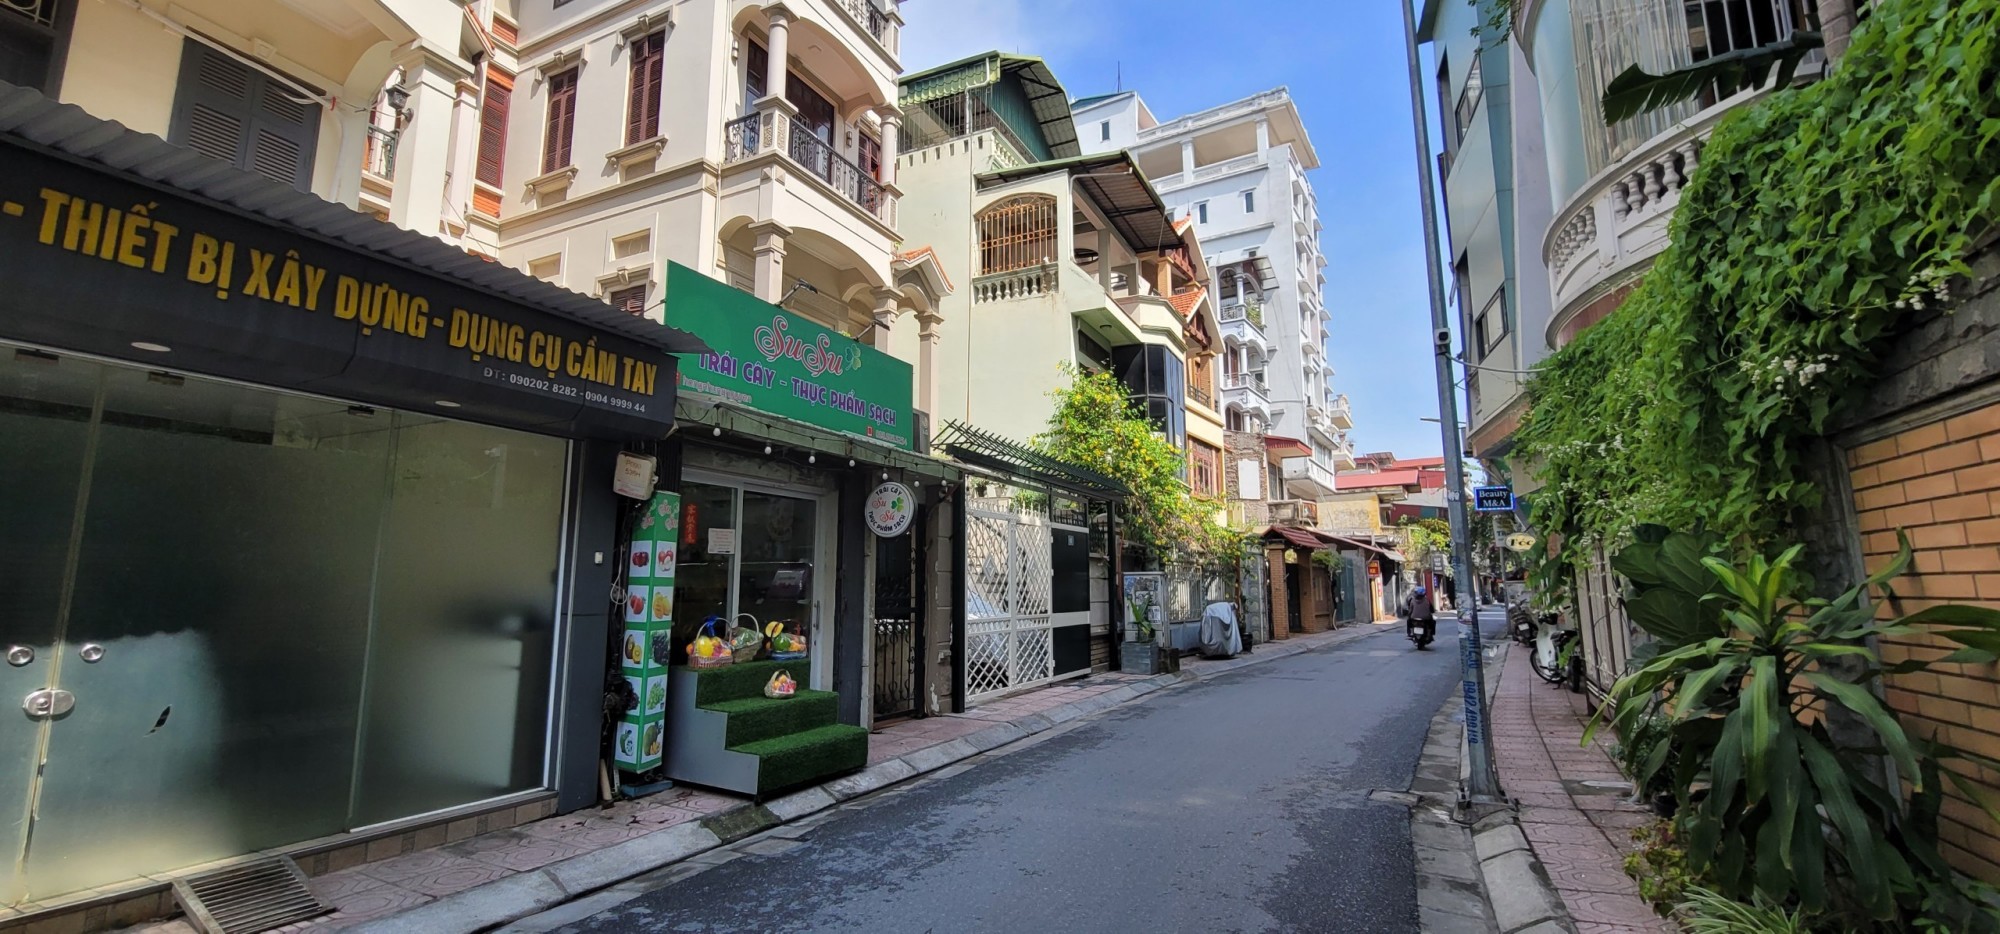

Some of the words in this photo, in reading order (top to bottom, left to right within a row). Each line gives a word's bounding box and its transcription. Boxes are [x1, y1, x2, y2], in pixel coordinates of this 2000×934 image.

[38, 187, 179, 274] THIẾT
[187, 232, 235, 300] BỊ
[243, 249, 326, 311] XÂY
[334, 275, 429, 338] DỰNG
[450, 308, 525, 362] DỤNG
[528, 331, 562, 378] CỤ
[566, 335, 616, 386] CẦM
[622, 357, 658, 396] TAY
[509, 373, 549, 391] 090202
[552, 383, 577, 397] 8282
[585, 391, 608, 404] 0904
[633, 403, 646, 413] 44
[742, 360, 776, 389] CÂY
[868, 403, 896, 427] SẠCH
[1479, 490, 1508, 498] Beauty
